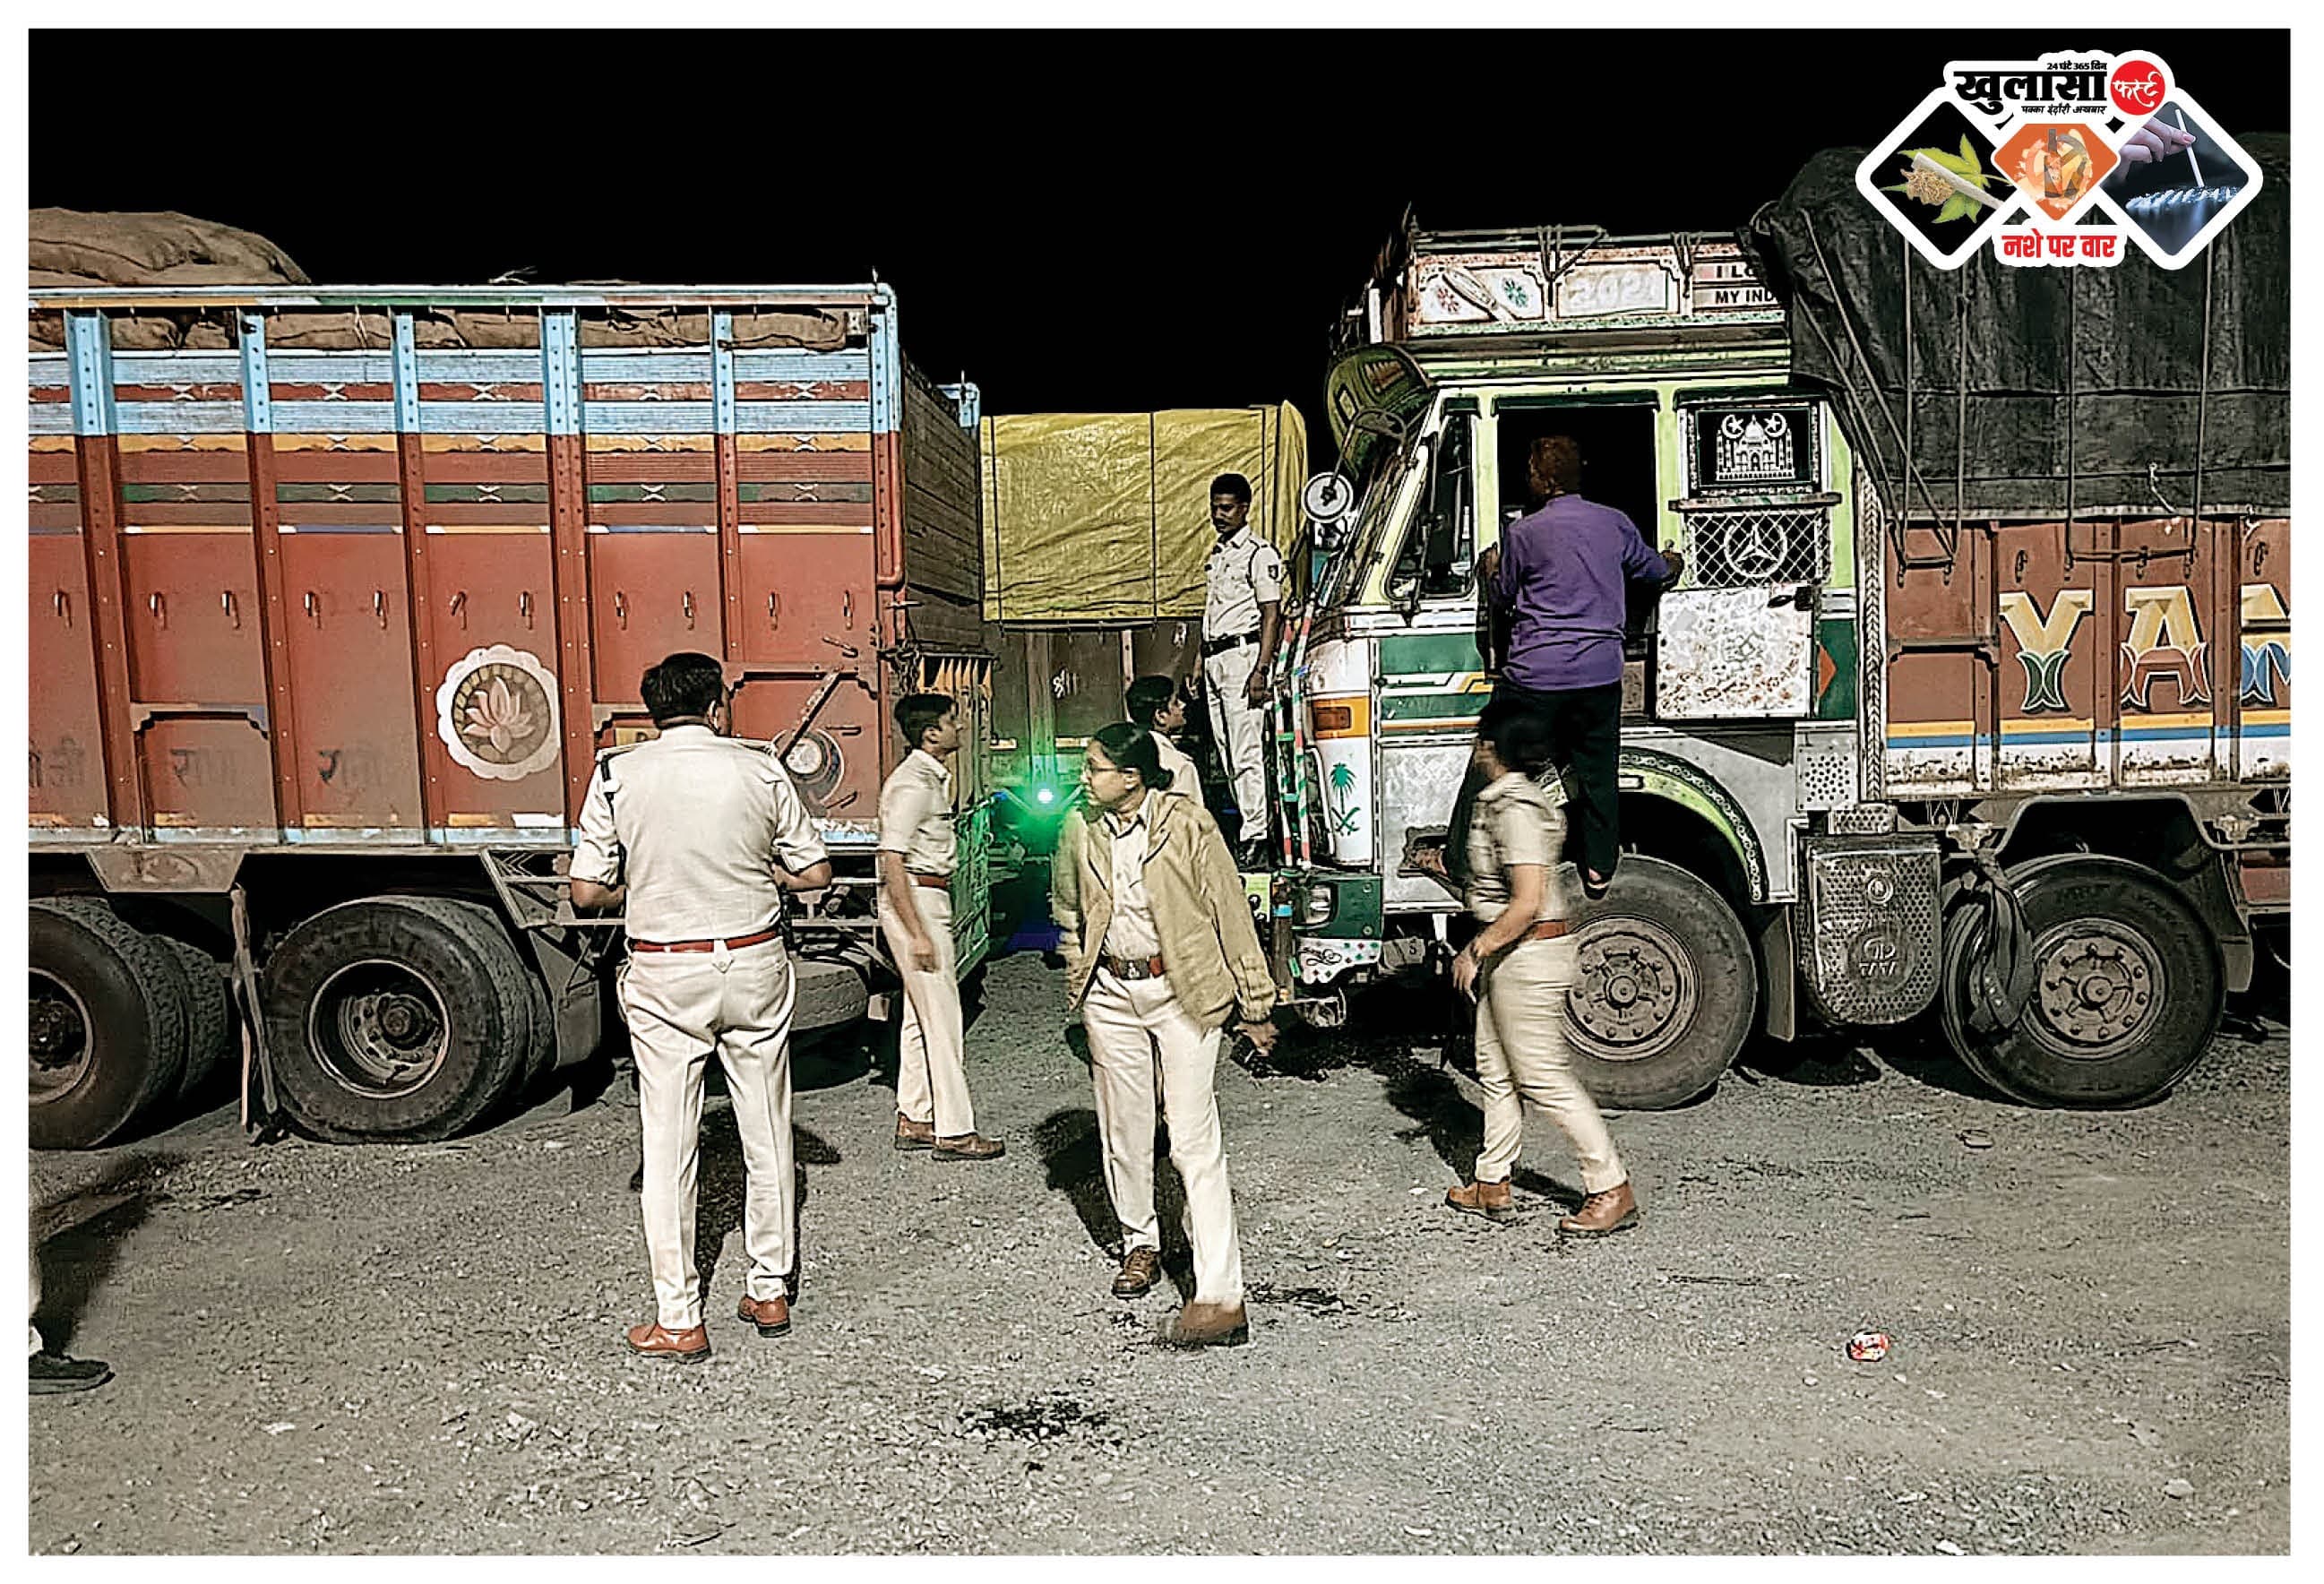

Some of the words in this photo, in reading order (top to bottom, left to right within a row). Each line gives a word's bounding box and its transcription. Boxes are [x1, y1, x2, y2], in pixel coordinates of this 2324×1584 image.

[1716, 264, 1723, 279] I
[1731, 264, 1757, 279] LO
[1716, 289, 1739, 304] MY
[1745, 288, 1776, 303] IND
